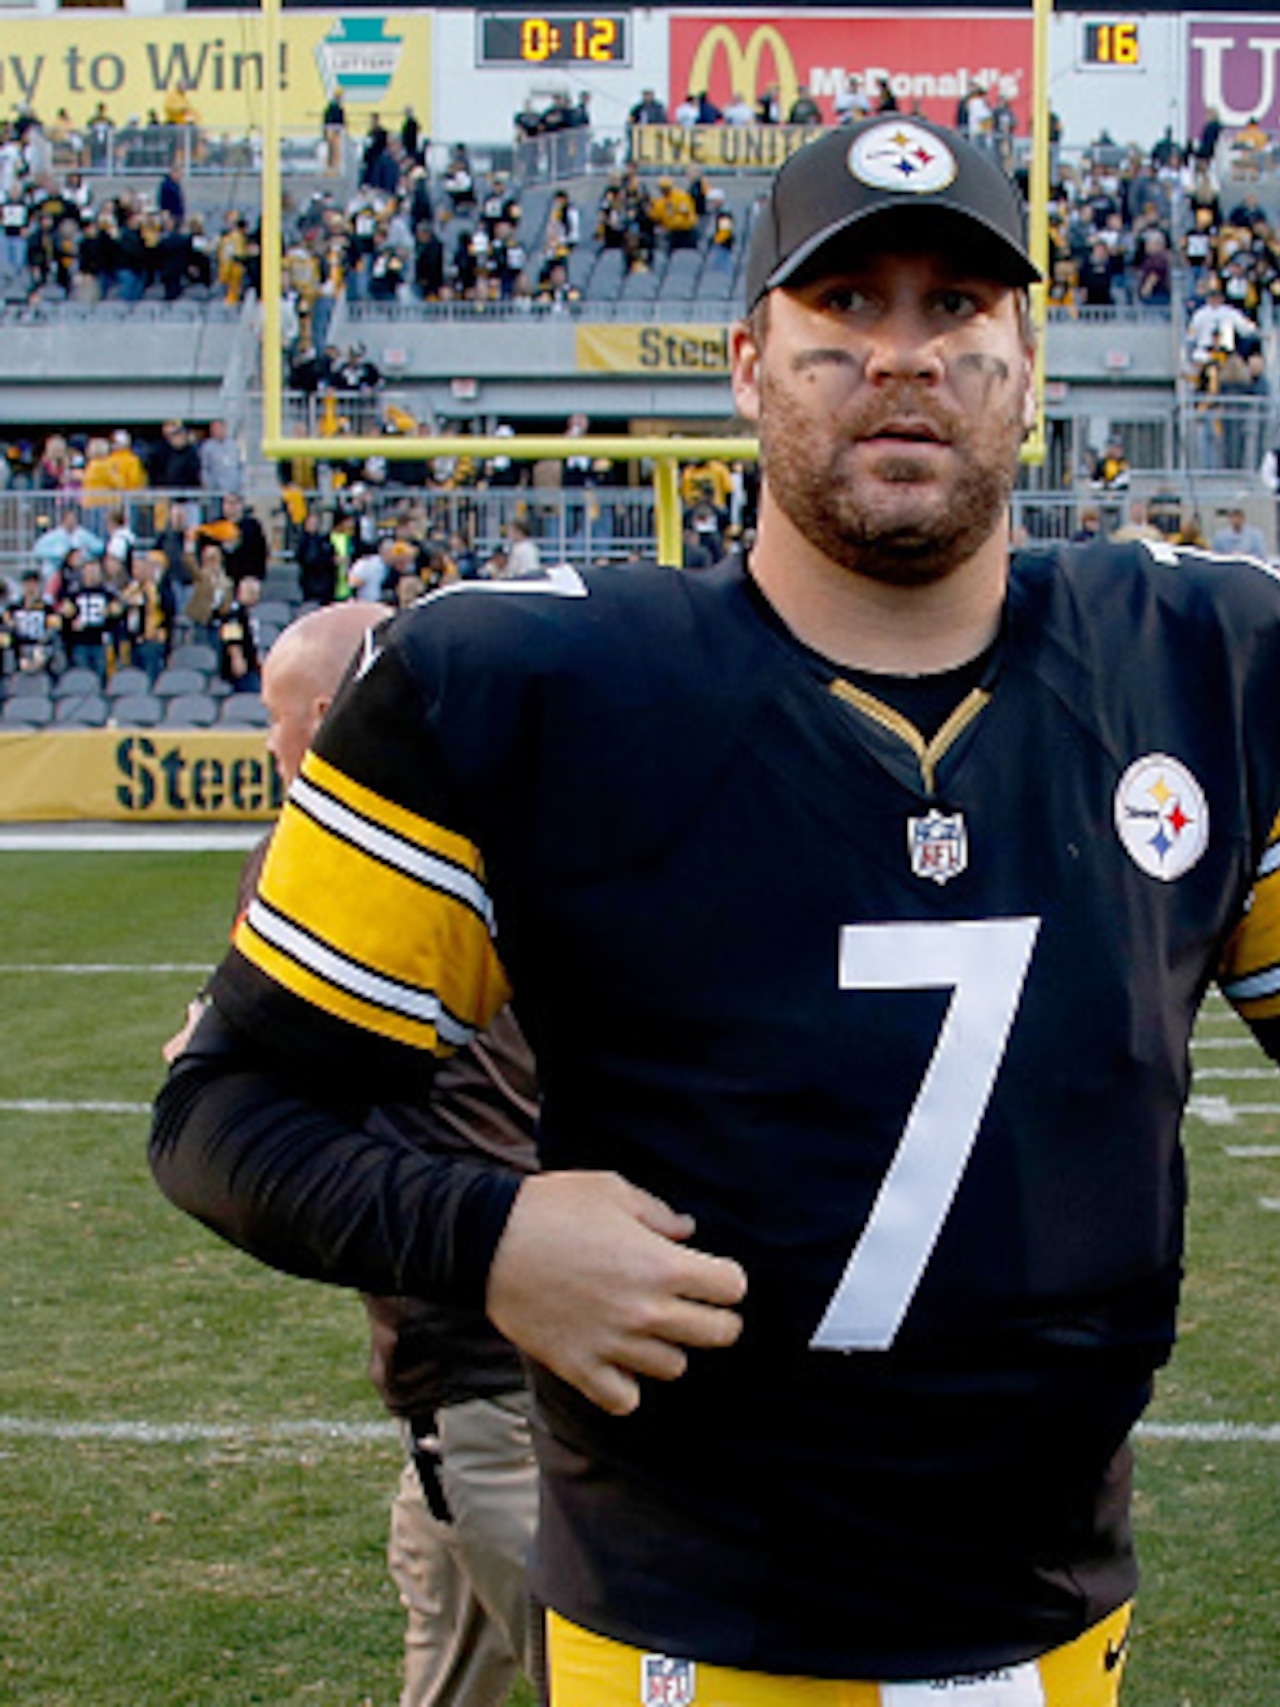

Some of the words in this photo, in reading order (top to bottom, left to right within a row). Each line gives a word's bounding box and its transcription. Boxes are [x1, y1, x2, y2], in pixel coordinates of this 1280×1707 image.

[522, 17, 617, 62] 0:12
[1097, 22, 1140, 64] 16
[0, 54, 45, 103] y
[64, 46, 125, 92] to
[146, 38, 288, 91] Win!
[637, 127, 705, 163] LIVE
[808, 915, 1042, 1352] 7
